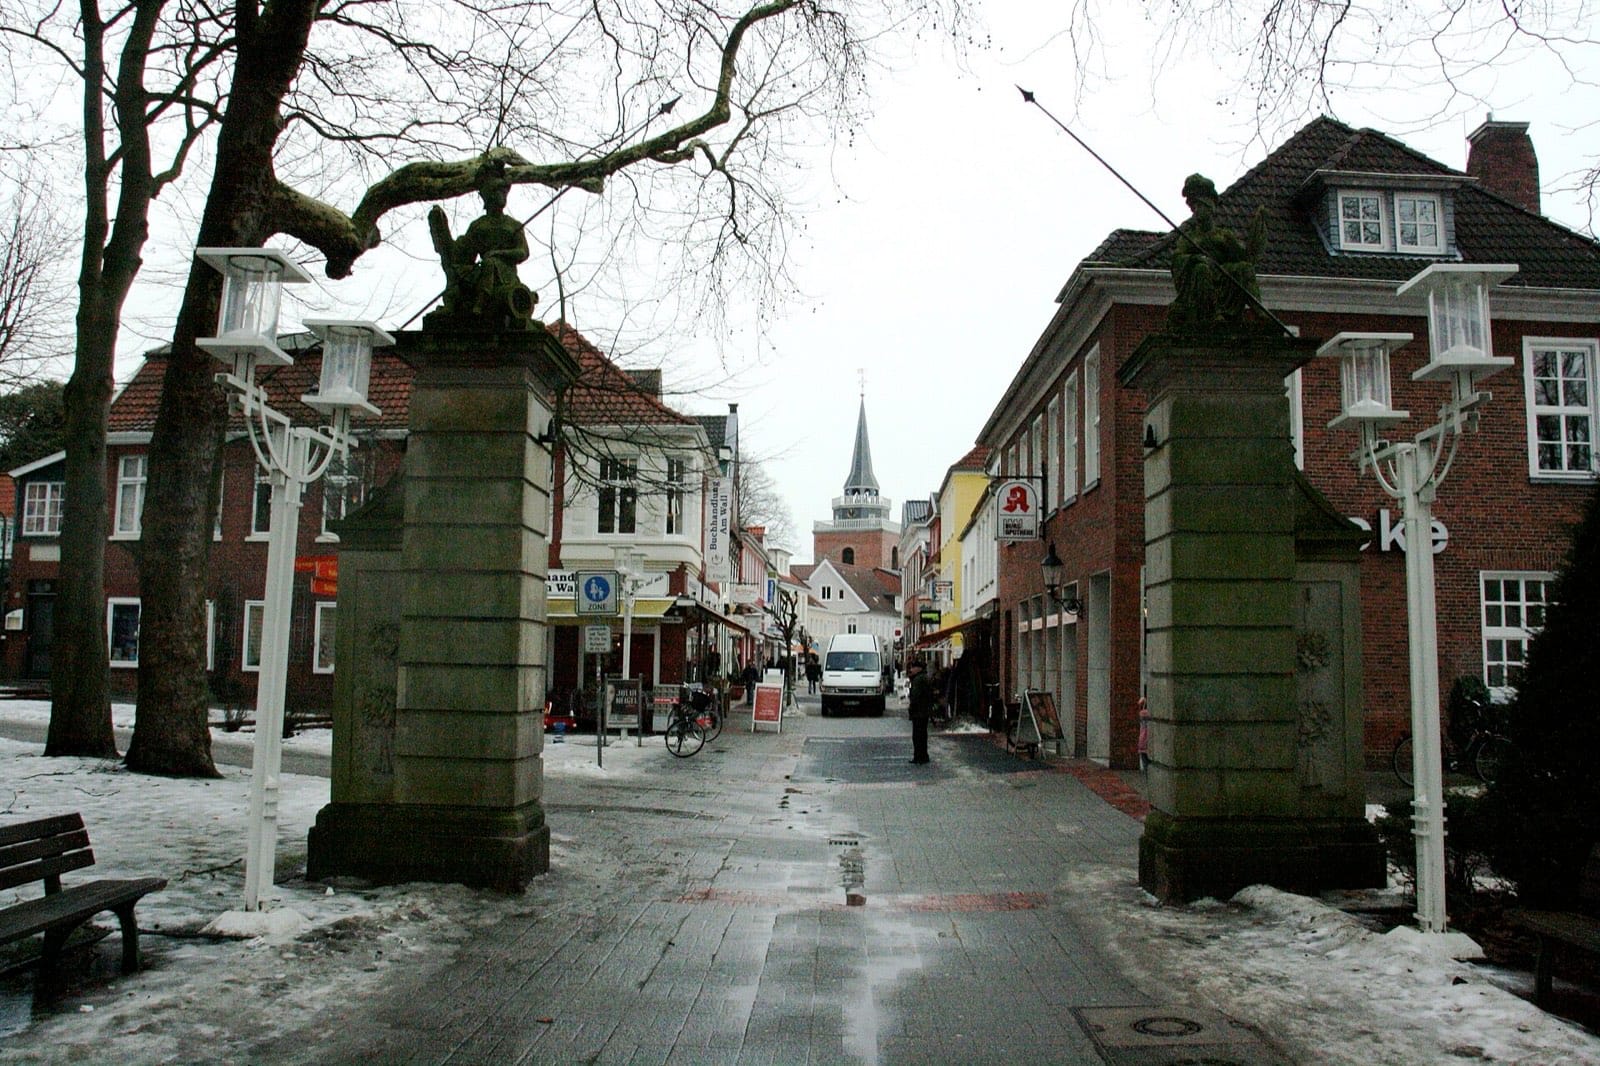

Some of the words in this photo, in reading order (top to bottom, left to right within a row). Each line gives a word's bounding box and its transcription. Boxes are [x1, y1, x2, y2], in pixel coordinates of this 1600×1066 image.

[720, 494, 728, 515] Wall
[710, 480, 720, 551] Buchhandlung
[720, 518, 728, 535] Am
